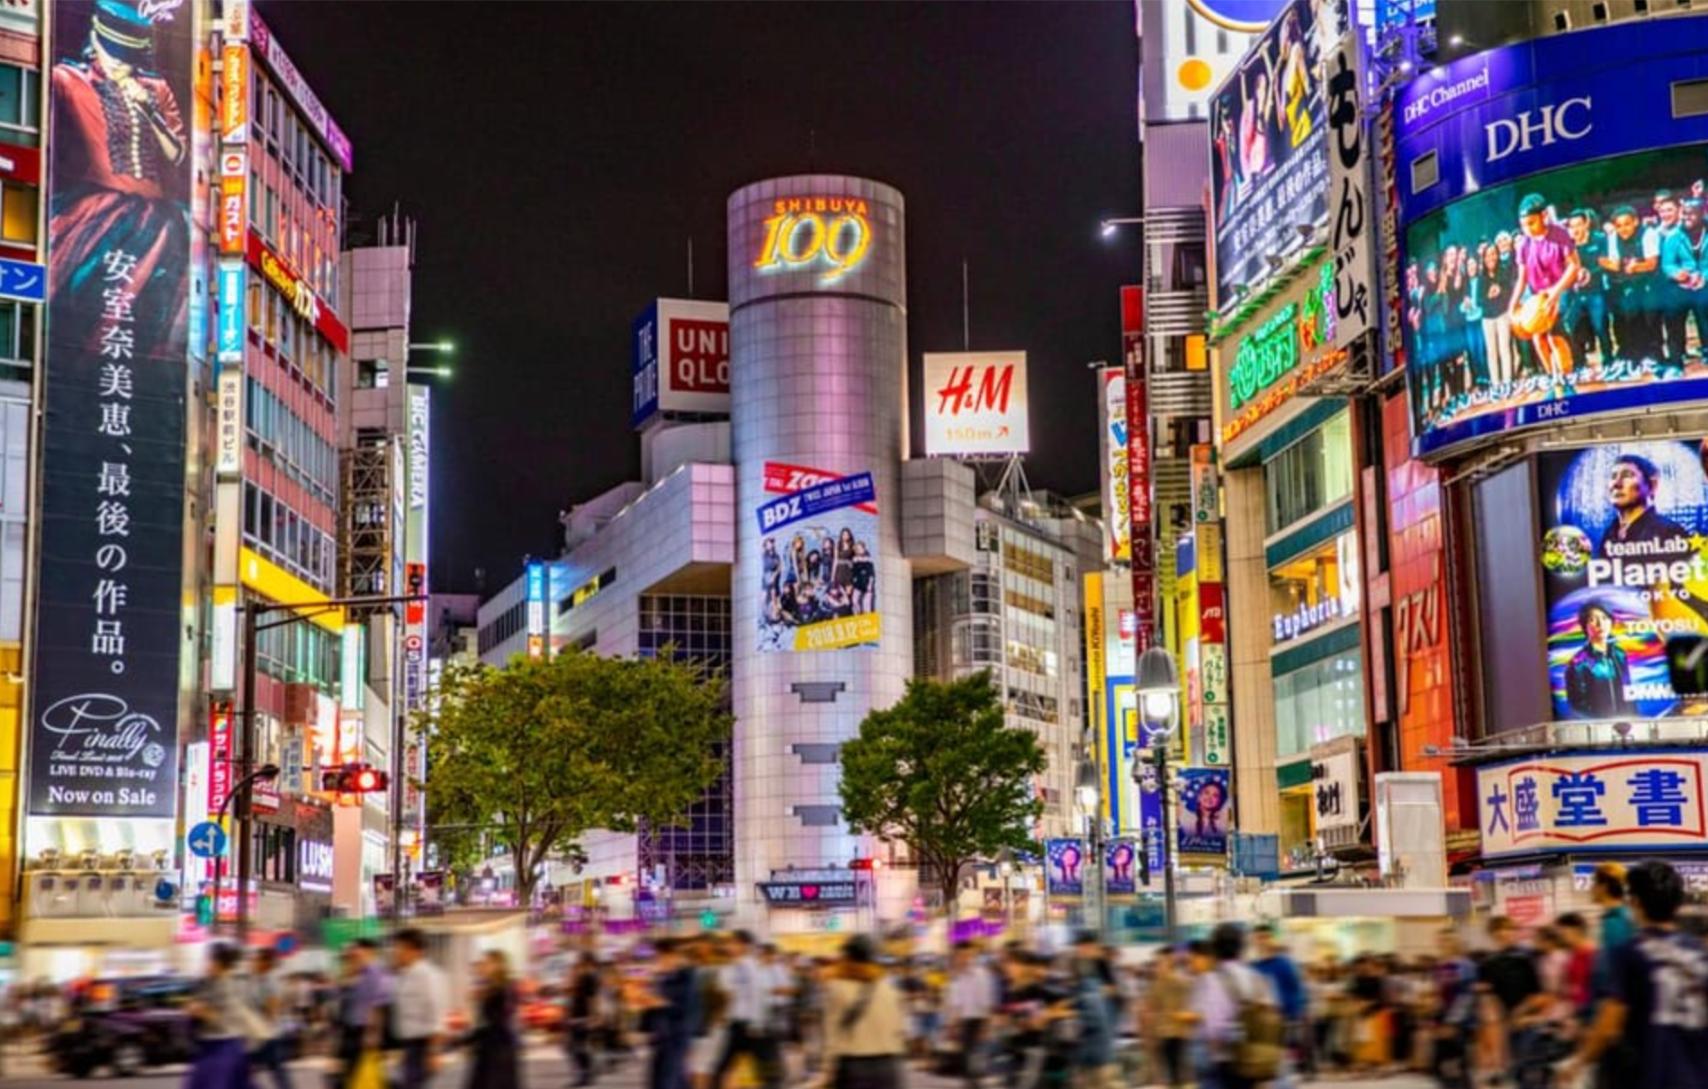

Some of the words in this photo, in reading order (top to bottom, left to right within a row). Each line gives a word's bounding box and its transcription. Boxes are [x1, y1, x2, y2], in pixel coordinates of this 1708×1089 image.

[1404, 95, 1431, 124] DHC
[1430, 68, 1489, 107] Channel
[1485, 96, 1592, 163] DHC
[774, 198, 866, 215] SHIBUYA
[1328, 50, 1368, 326] もんじゃ
[226, 195, 241, 242] ガスト
[753, 212, 871, 279] 109
[678, 328, 727, 355] UNI
[937, 363, 1014, 416] H&M
[1537, 401, 1570, 419] DHC
[92, 248, 136, 674] 安室奈美恵、最後の作品。
[763, 497, 802, 528] BDZ
[1604, 536, 1689, 557] teamLab
[1625, 618, 1699, 634] TOYOSU
[41, 693, 161, 761] Finally
[48, 785, 90, 804] Now
[92, 789, 114, 805] on
[118, 787, 157, 806] Sale
[50, 764, 77, 776] LIVE
[79, 765, 104, 778] DVD
[116, 767, 157, 781] Blu-ray
[1487, 769, 1688, 836] 大盛堂書
